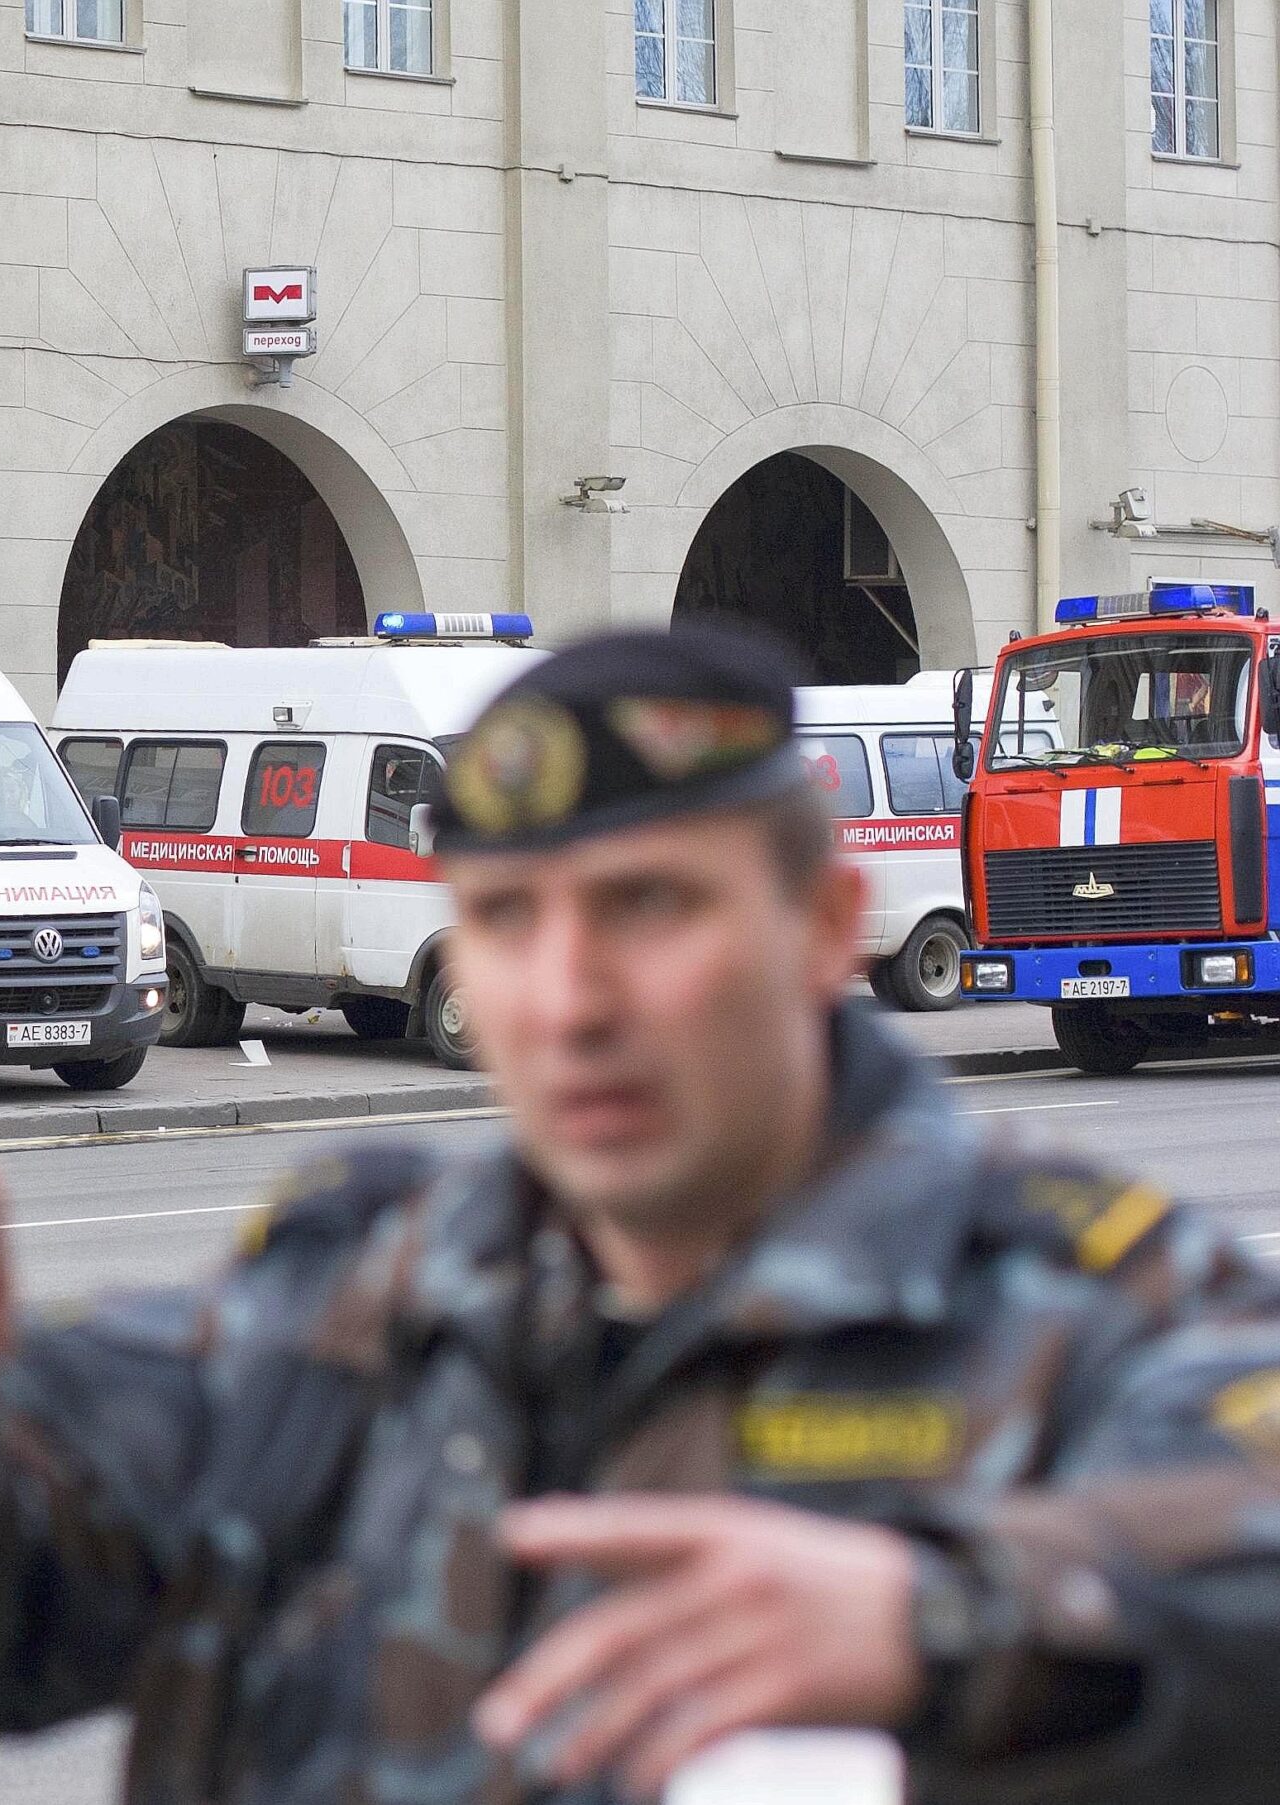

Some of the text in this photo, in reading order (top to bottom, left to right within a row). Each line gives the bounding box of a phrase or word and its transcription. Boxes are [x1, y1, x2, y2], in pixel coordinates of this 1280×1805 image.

[253, 336, 301, 348] переход
[260, 765, 316, 810] 103
[842, 825, 955, 846] МЕДИЦИНСКАЯ
[130, 841, 233, 863] МЕДИЦИНСКАЯ
[258, 846, 320, 868] ПОМОЩЬ
[1072, 981, 1088, 996] AE
[1091, 980, 1126, 996] 2197-7
[21, 1025, 42, 1041] AE
[44, 1023, 89, 1040] 8383-7
